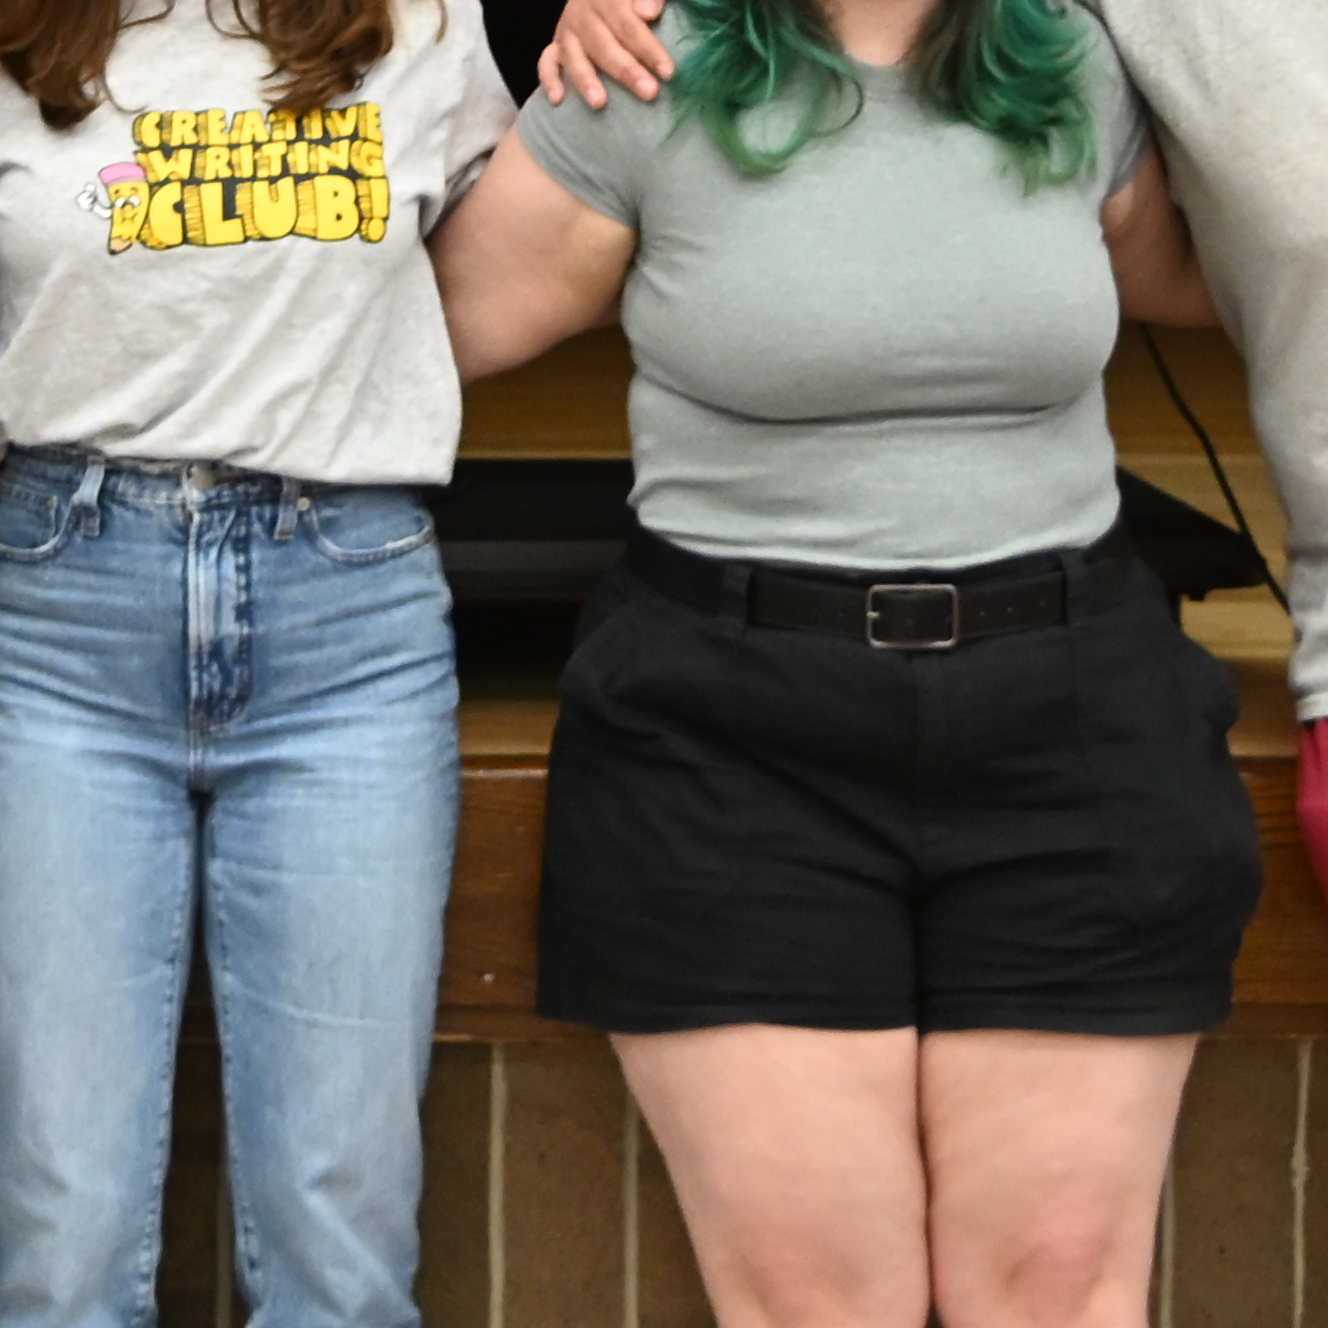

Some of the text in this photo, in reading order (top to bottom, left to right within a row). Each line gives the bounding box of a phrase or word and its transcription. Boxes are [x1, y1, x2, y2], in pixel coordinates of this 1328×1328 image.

[133, 101, 383, 148] CREATIVE
[135, 139, 386, 184] WRITING
[140, 174, 390, 249] CLUB!
